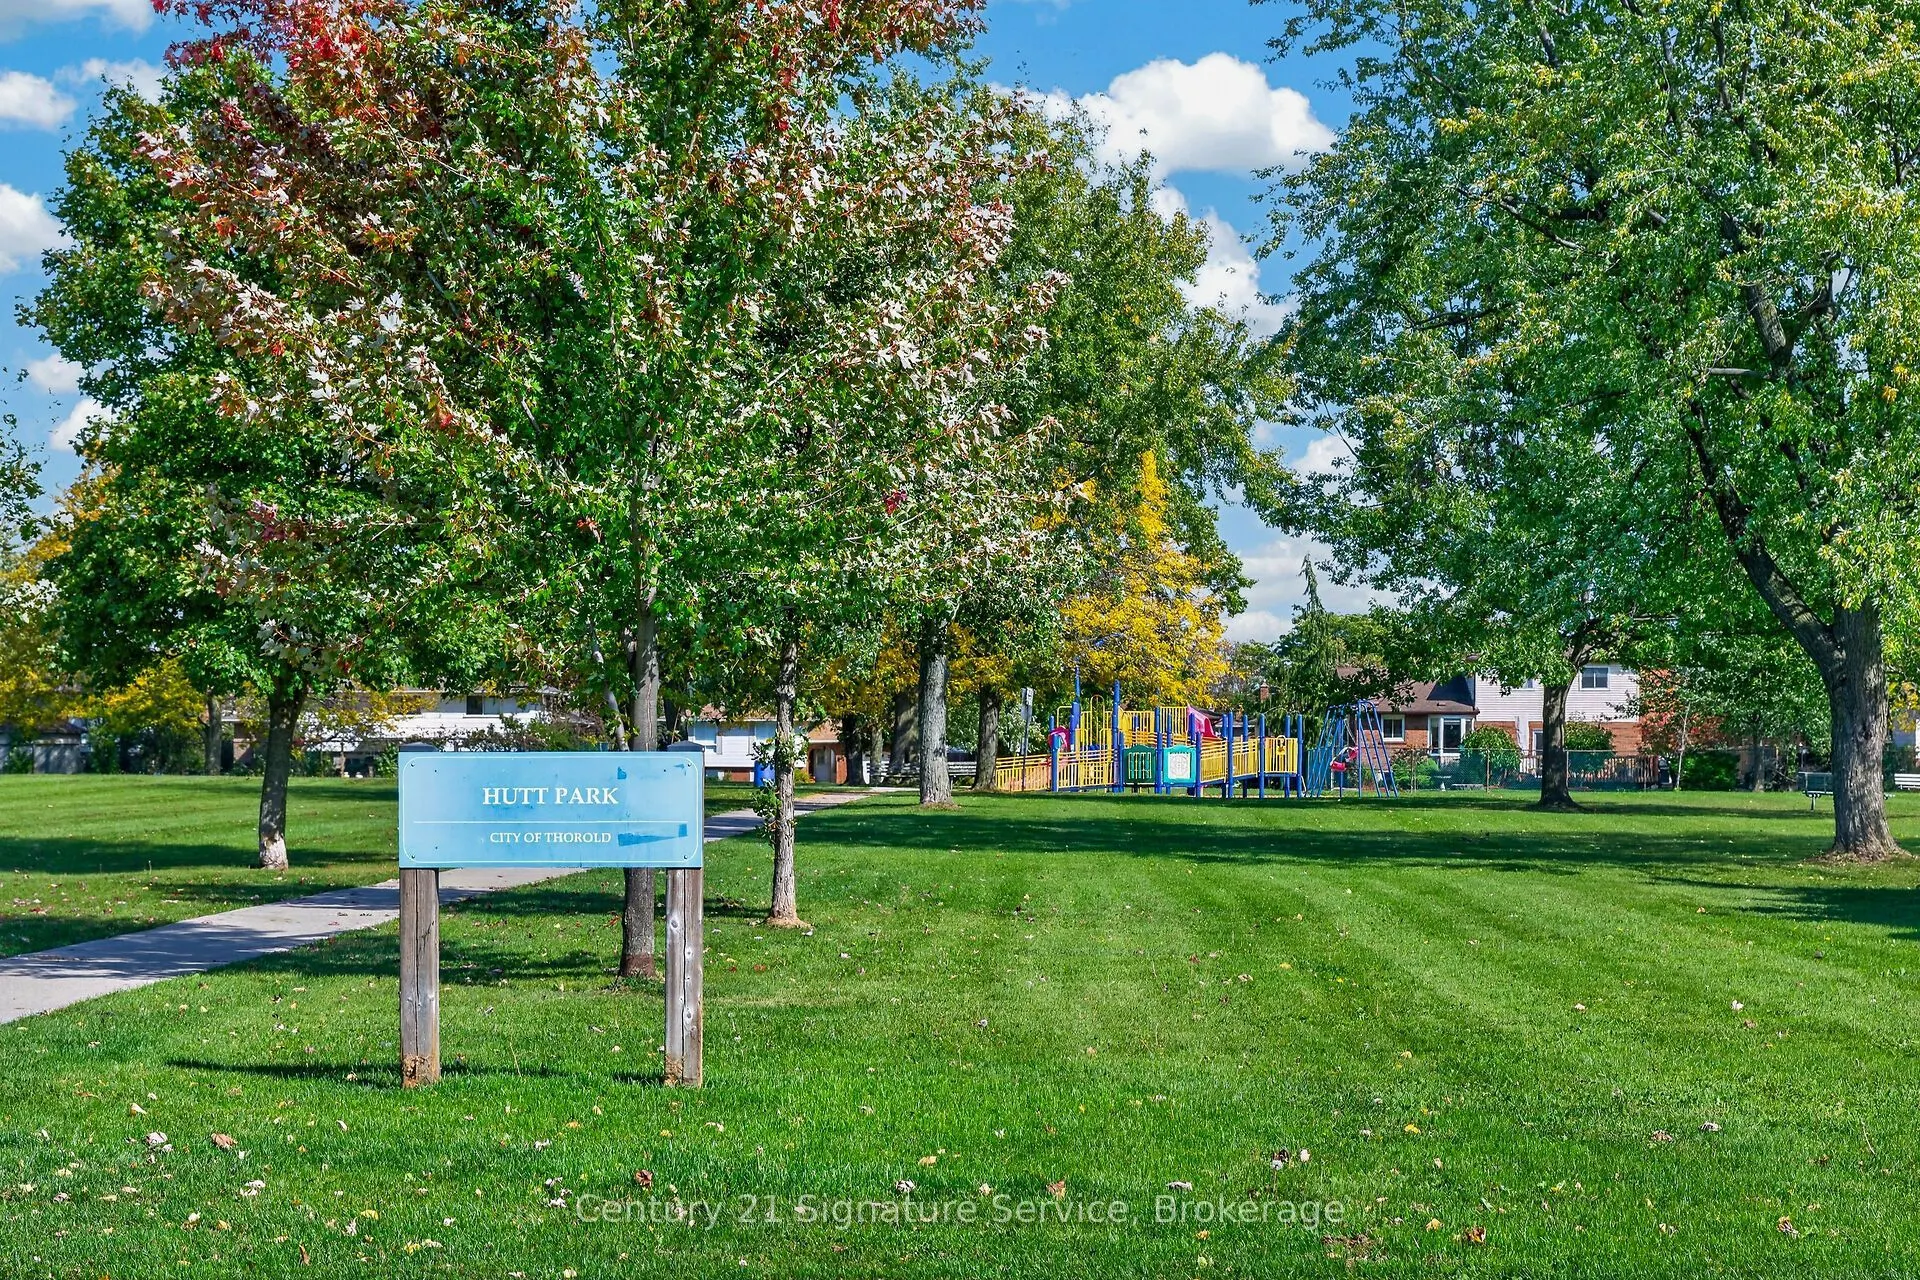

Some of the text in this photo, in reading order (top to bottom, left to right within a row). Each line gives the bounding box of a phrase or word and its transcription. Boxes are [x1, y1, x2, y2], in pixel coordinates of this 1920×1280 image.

[482, 787, 619, 805] HUTT PARK
[489, 832, 611, 843] CITY OF THOROLD
